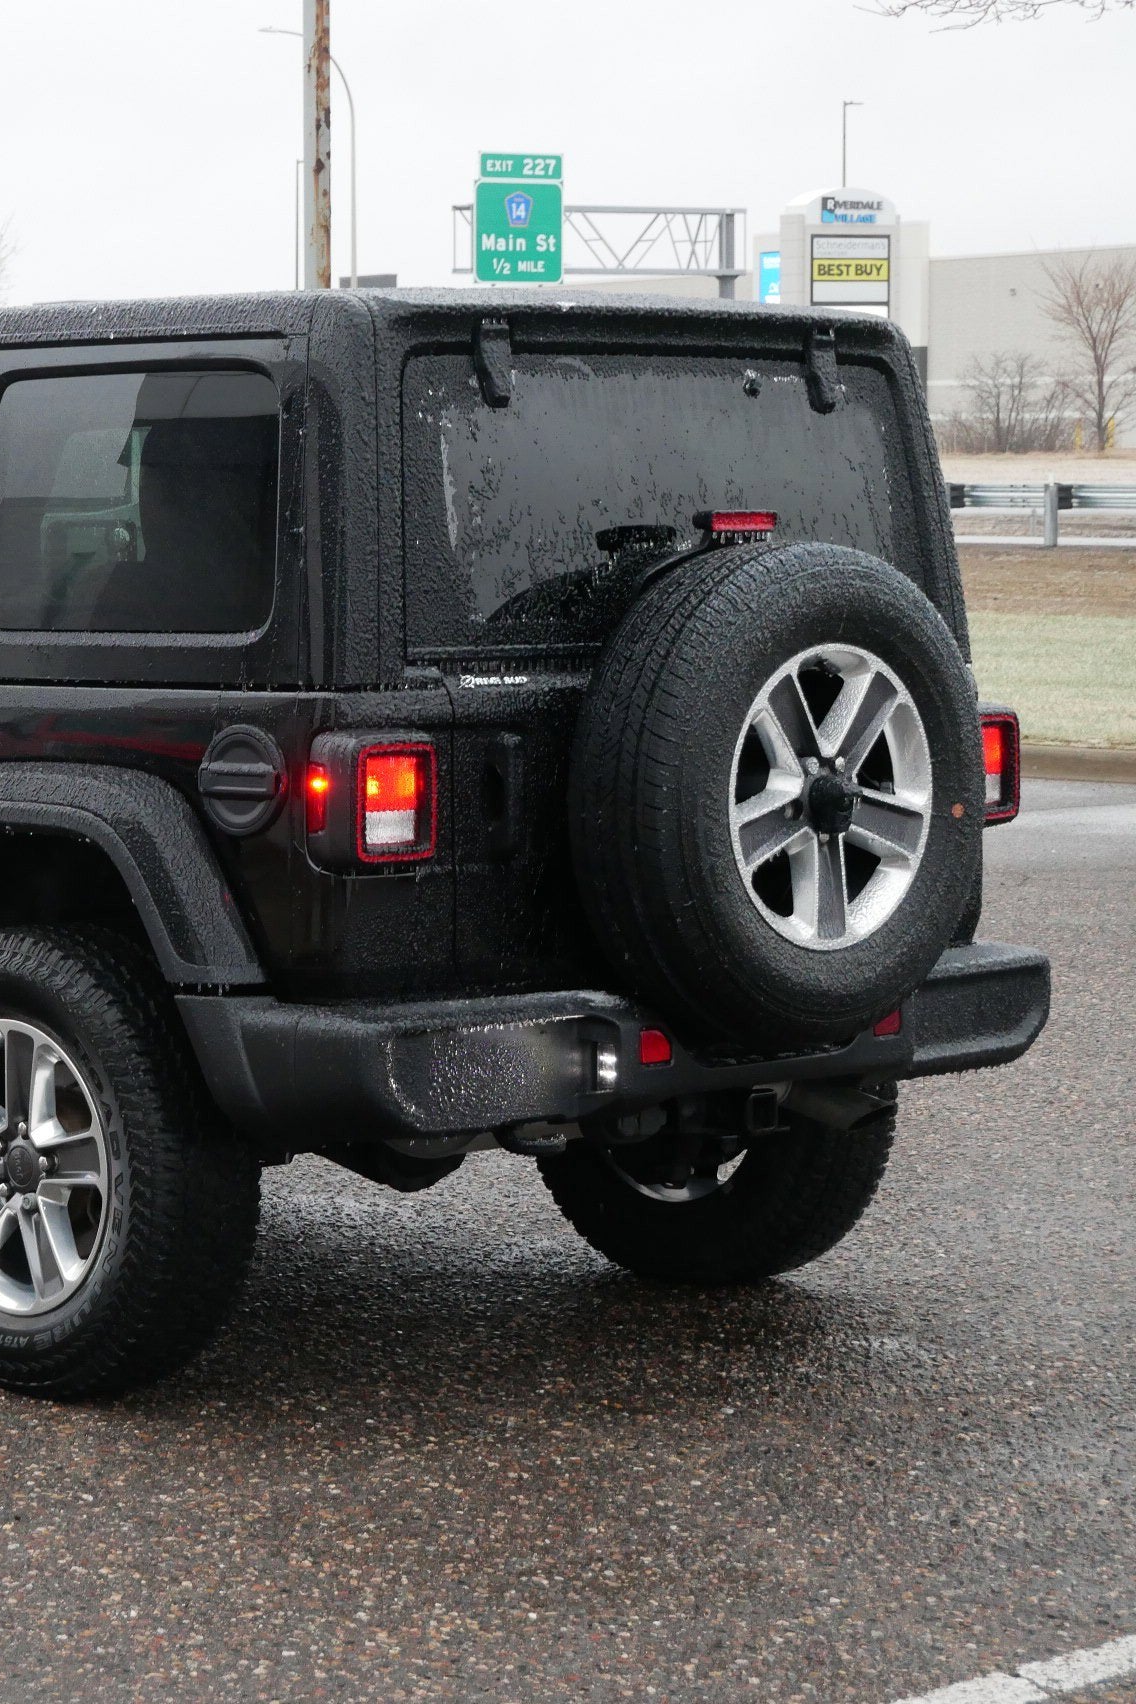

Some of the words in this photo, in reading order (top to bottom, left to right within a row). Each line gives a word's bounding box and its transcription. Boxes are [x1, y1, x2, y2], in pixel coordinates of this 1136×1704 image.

[486, 159, 514, 172] EXIT
[522, 158, 556, 175] 227
[511, 202, 526, 219] 14
[827, 198, 883, 210] RIVERDALE
[481, 233, 526, 251] Main
[535, 233, 556, 252] St
[517, 261, 545, 272] MILE
[817, 263, 852, 276] BEST
[855, 263, 883, 276] BUY
